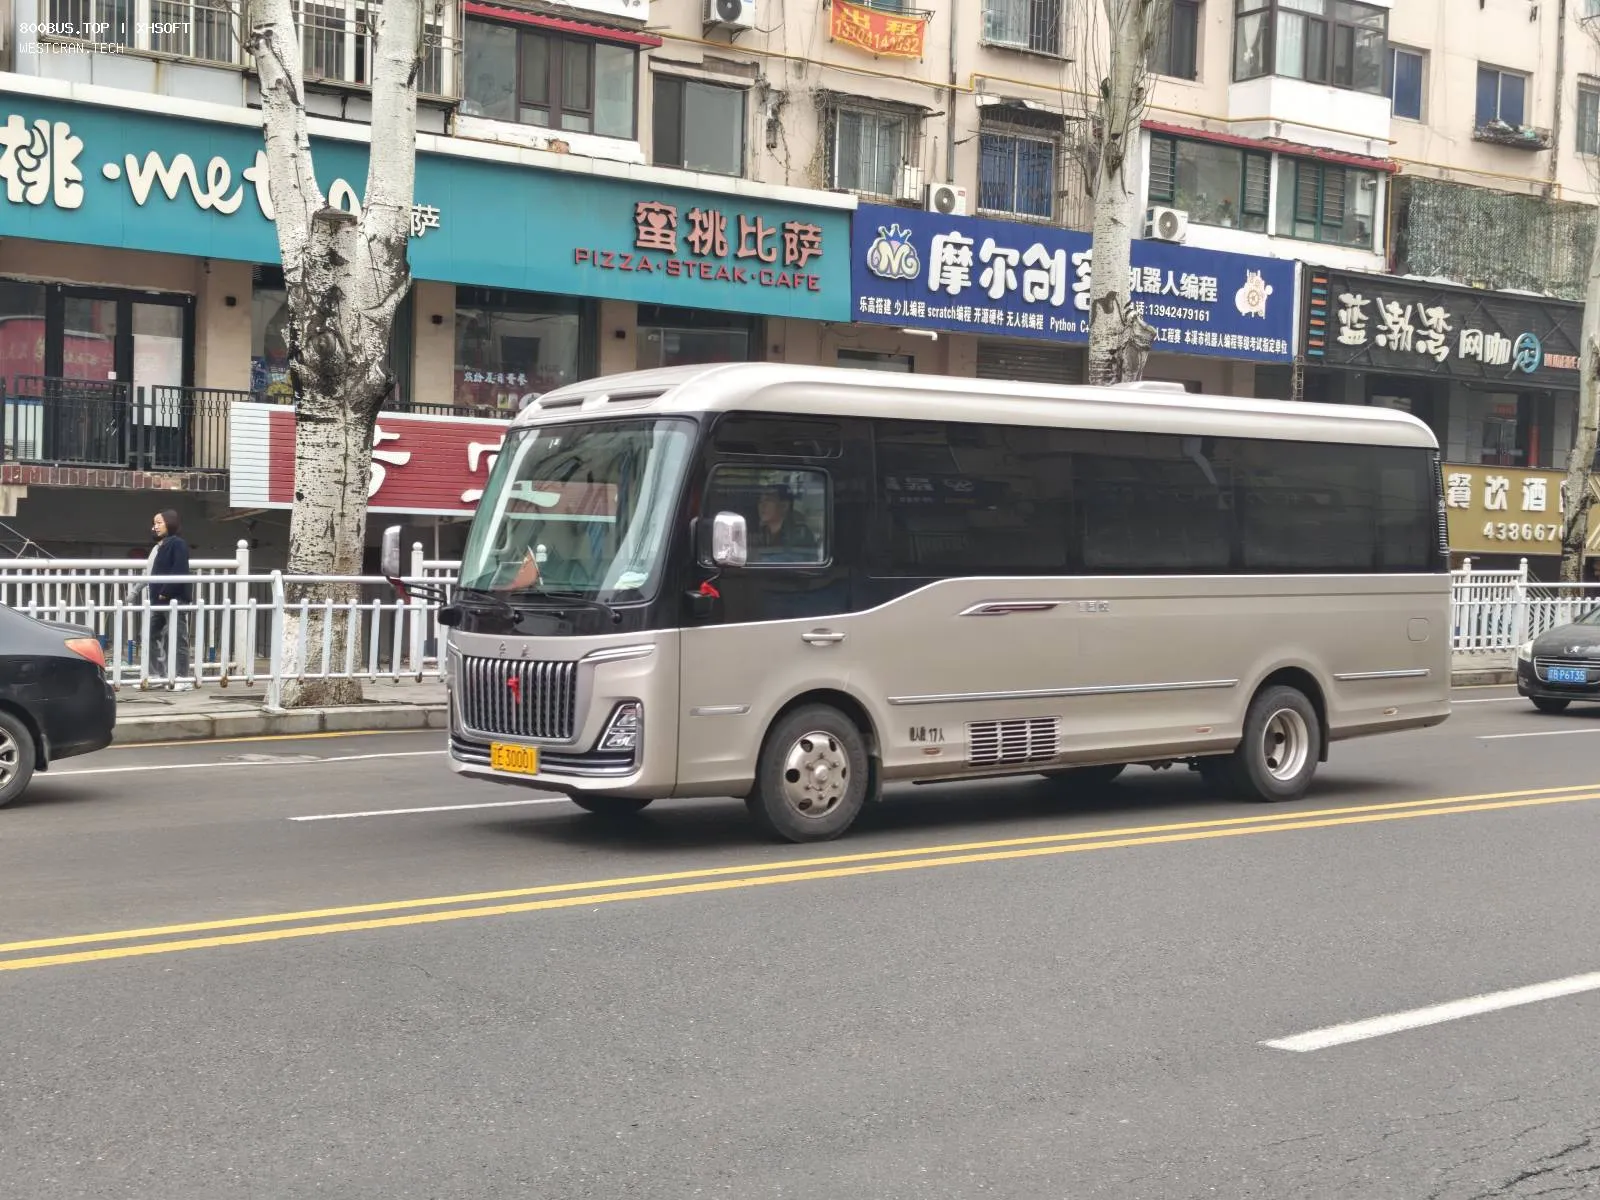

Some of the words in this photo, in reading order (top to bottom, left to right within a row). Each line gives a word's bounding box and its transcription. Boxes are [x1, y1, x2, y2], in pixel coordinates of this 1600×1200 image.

[411, 203, 441, 237] 萨
[634, 200, 824, 268] 蜜桃比萨
[1129, 265, 1218, 303] 机器人编程
[859, 296, 891, 316] 乐高搭建
[894, 300, 926, 319] 少儿编程
[973, 308, 1004, 326] 开源硬件
[1006, 311, 1044, 331] 无人机编程
[1050, 316, 1076, 333] Python
[1447, 472, 1564, 513] 餐饮酒
